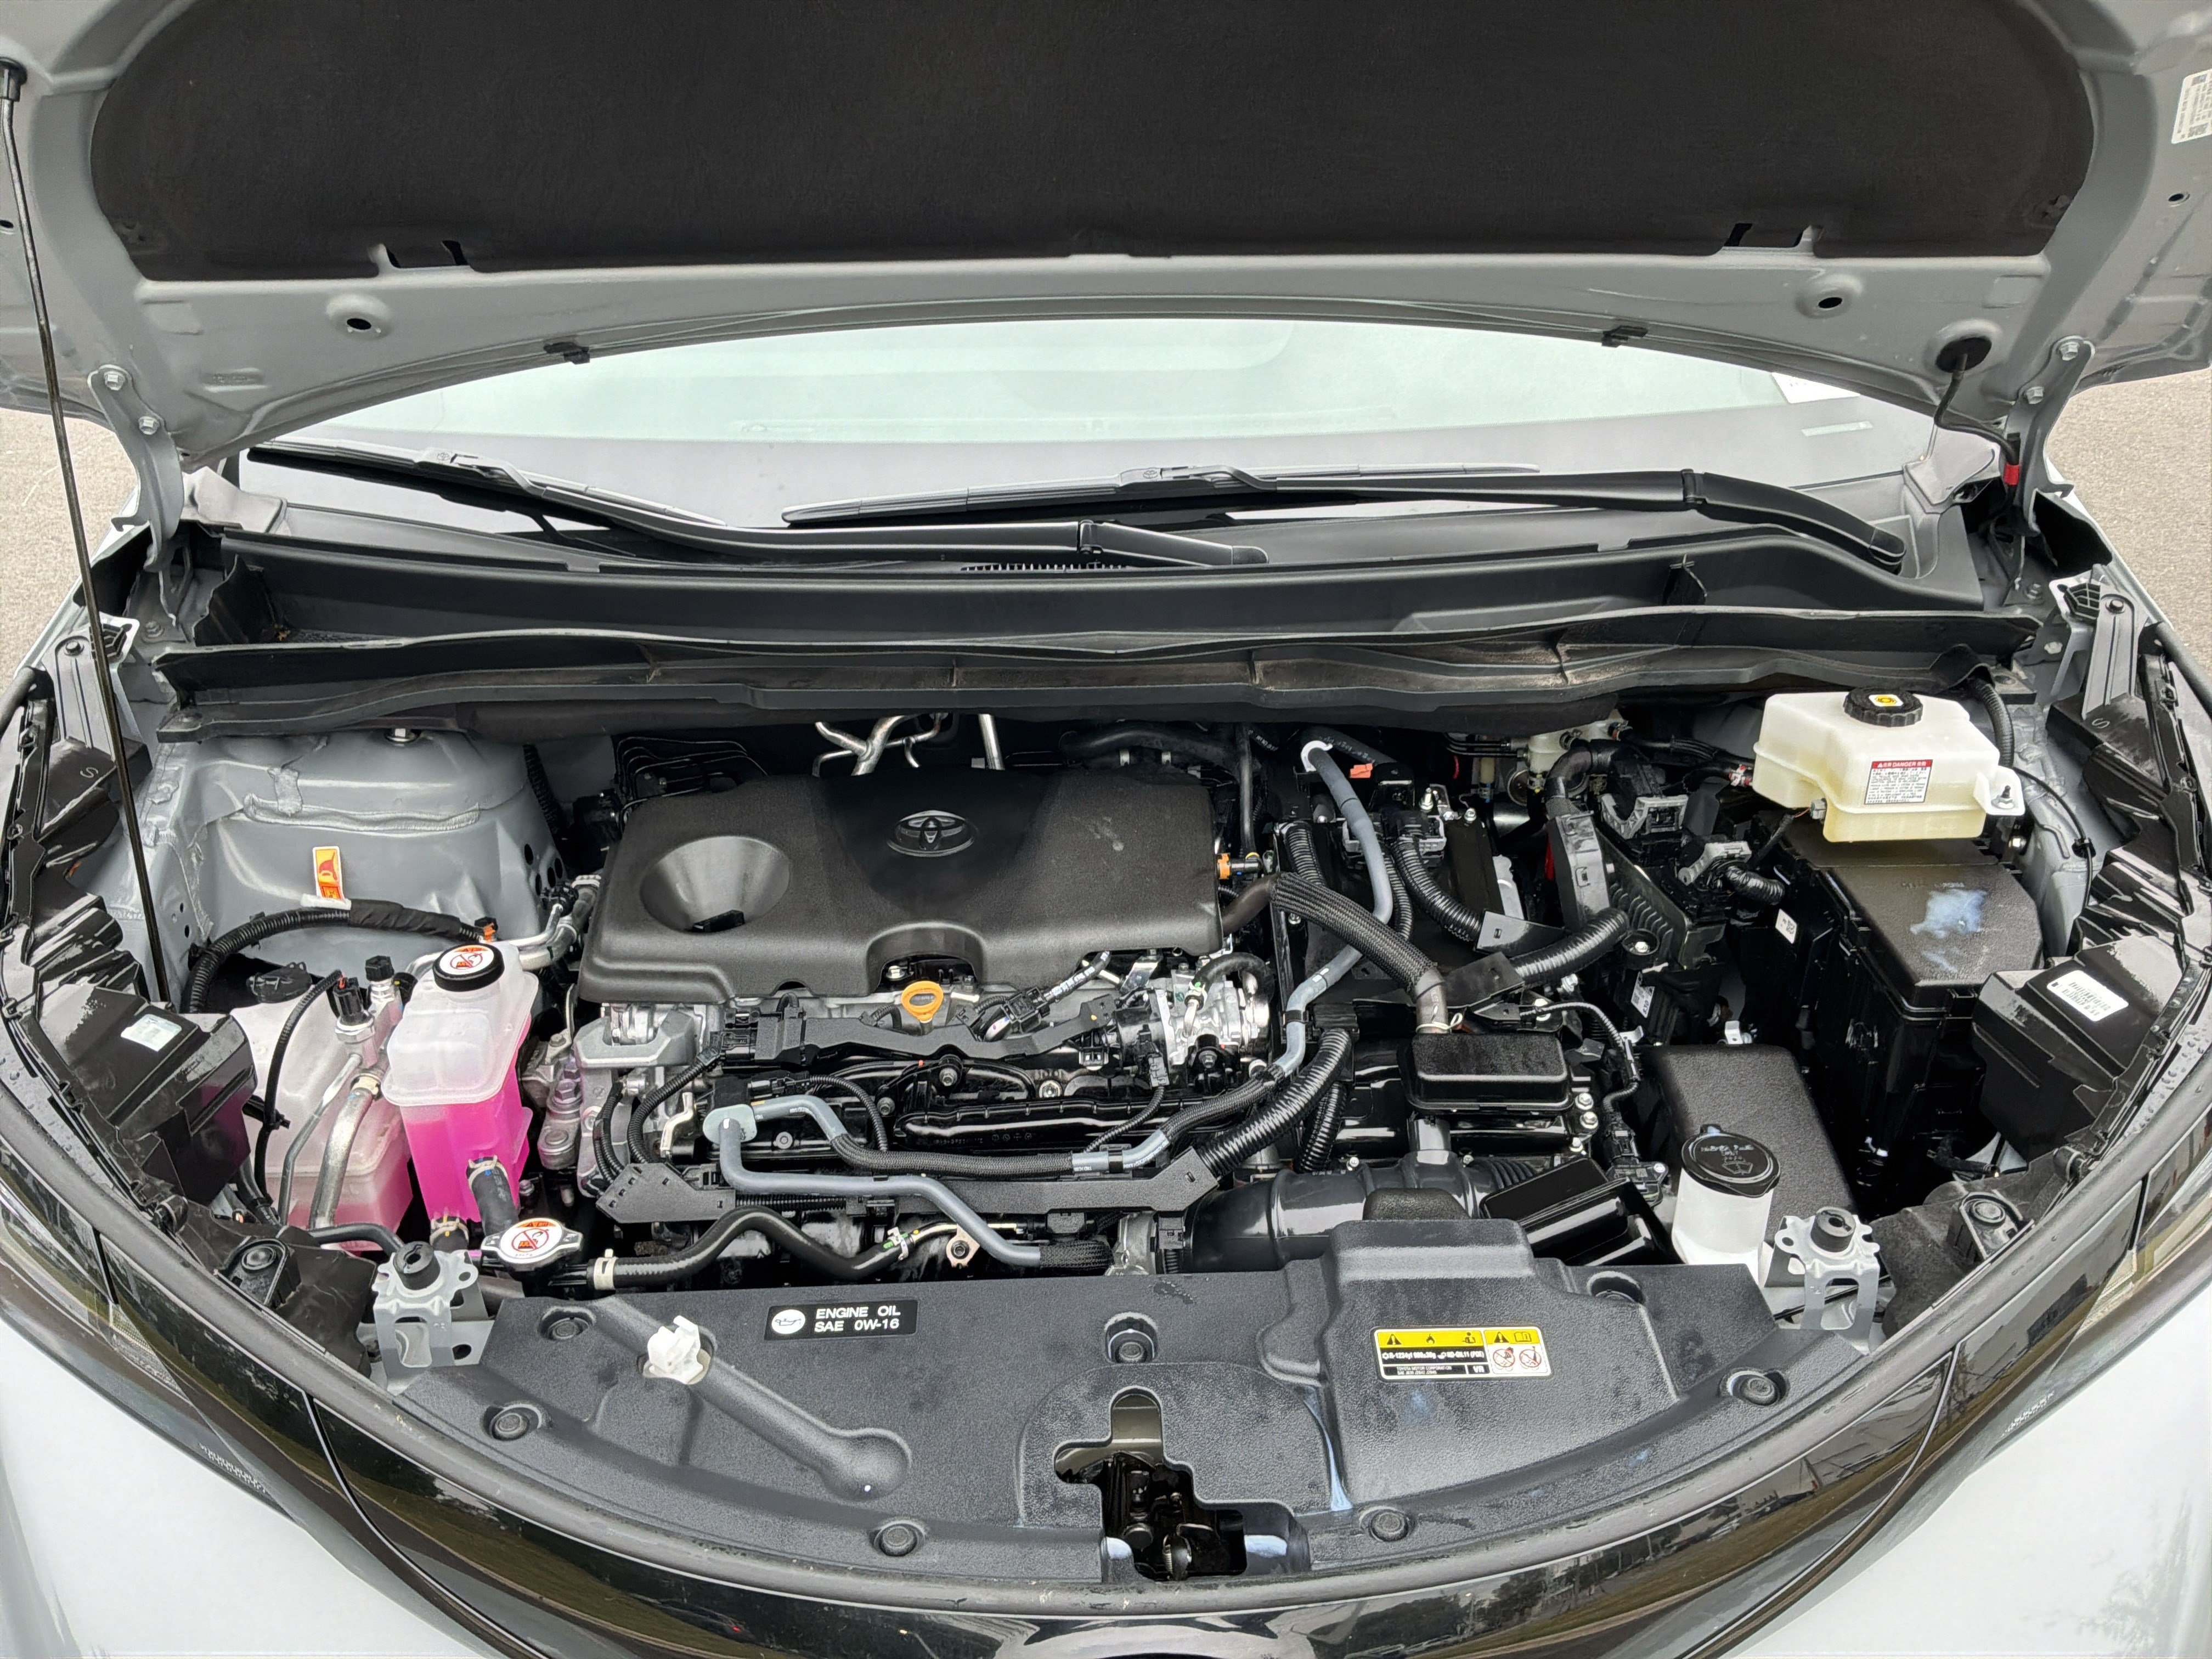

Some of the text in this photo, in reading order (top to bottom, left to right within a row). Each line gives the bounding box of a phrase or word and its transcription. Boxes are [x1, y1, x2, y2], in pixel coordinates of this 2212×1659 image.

[816, 1306, 901, 1319] ENGINE OIL
[815, 1318, 899, 1333] SAE 0W-16
